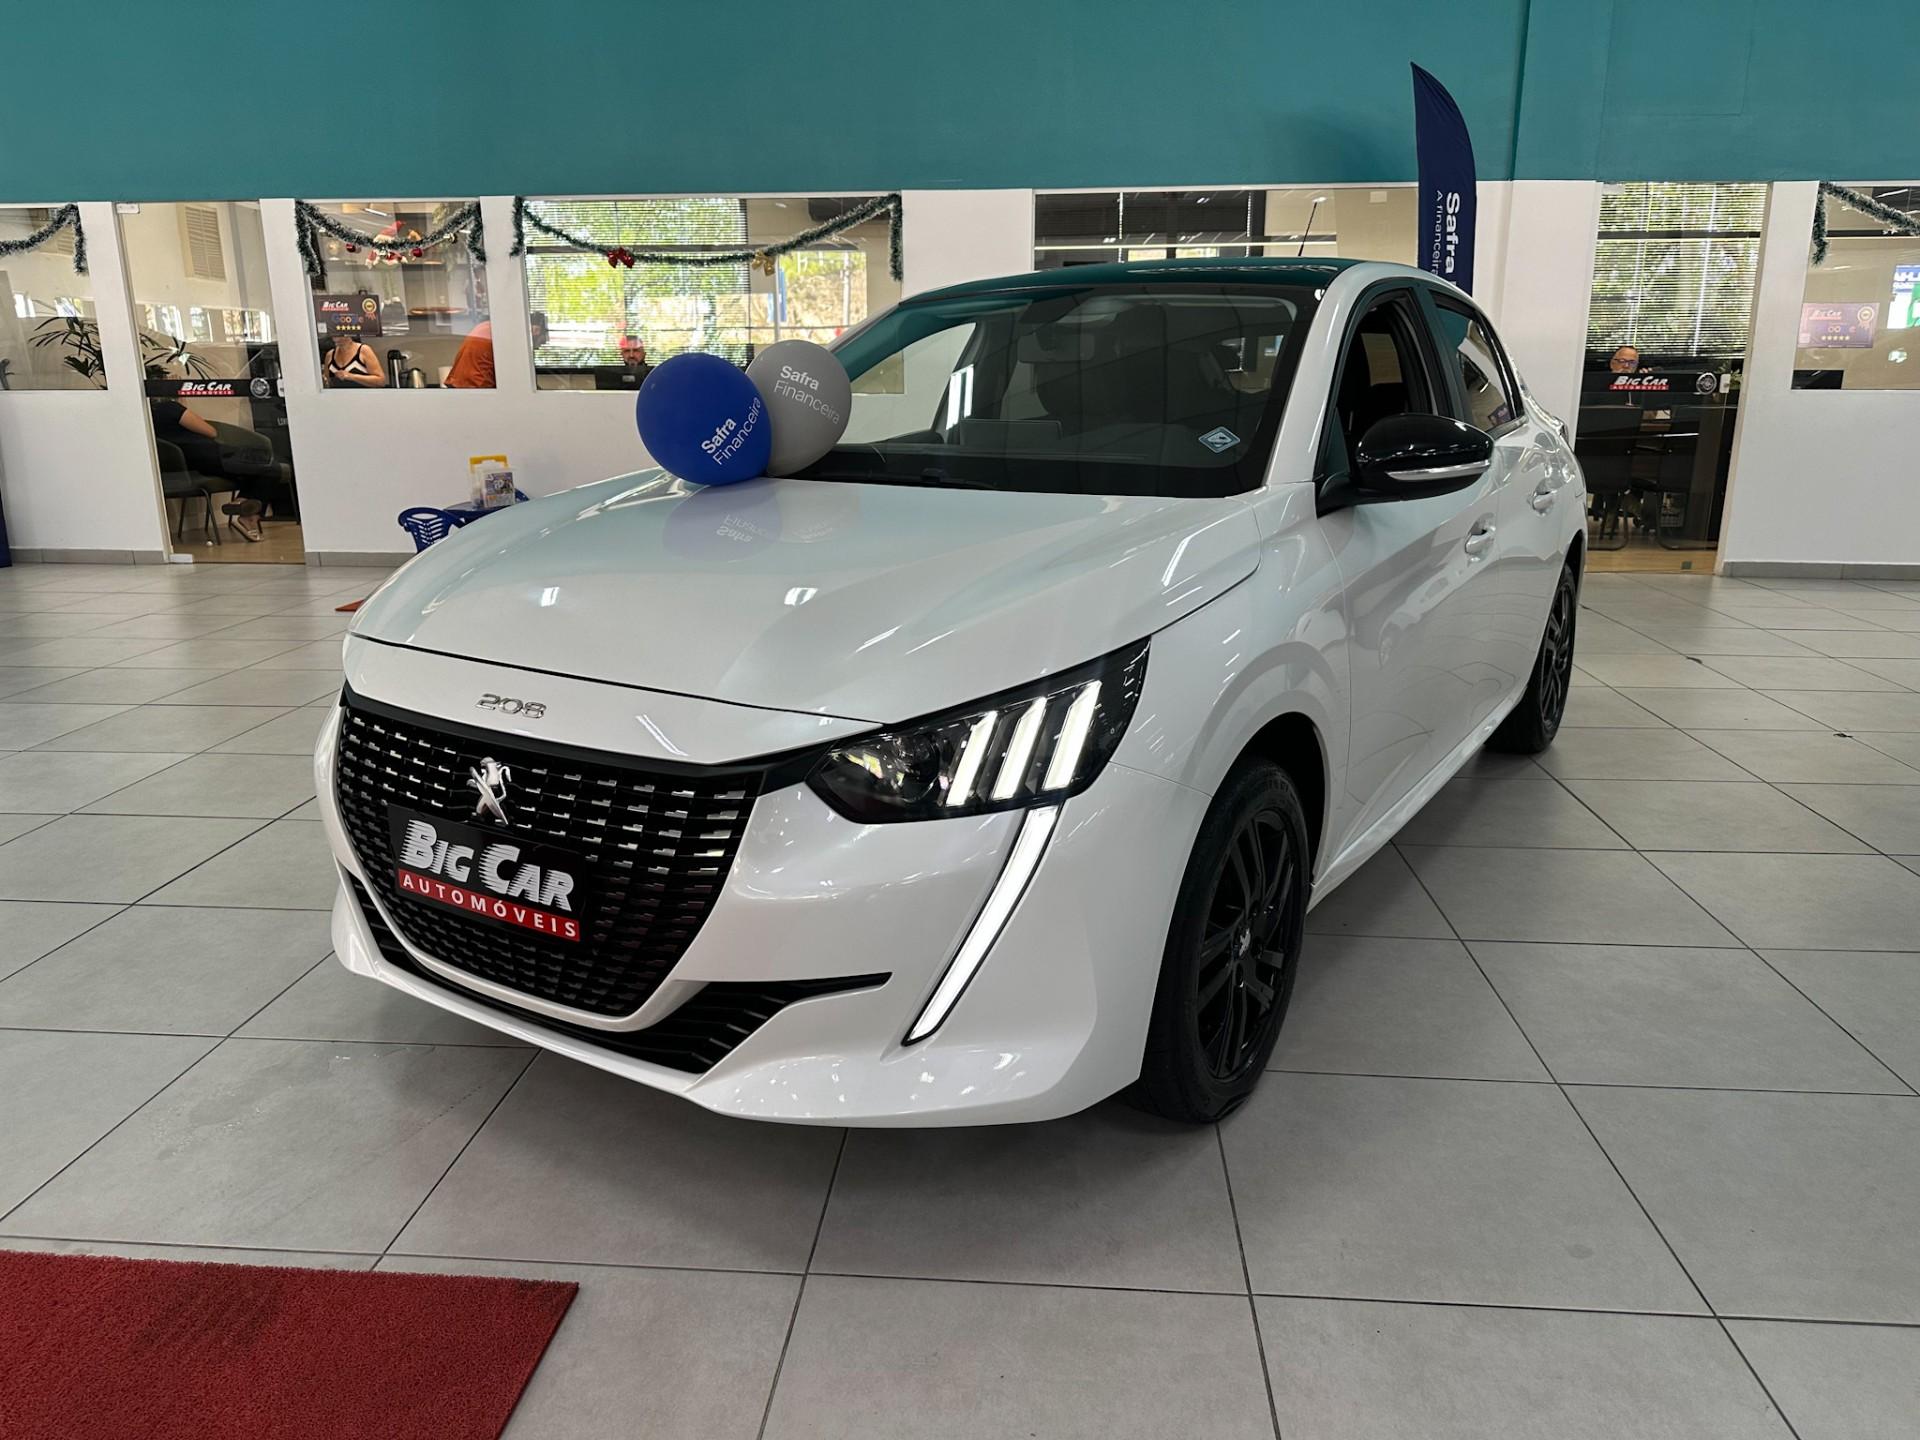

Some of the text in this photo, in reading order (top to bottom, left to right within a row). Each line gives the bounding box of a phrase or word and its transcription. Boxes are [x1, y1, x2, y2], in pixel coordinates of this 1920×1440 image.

[1436, 190, 1443, 201] A
[1445, 192, 1460, 274] Safra
[181, 381, 232, 392] BIG CAR
[780, 365, 820, 391] Safra
[1613, 375, 1669, 386] BIG CAR
[773, 379, 840, 425] Financeira
[701, 418, 737, 454] Safra
[712, 397, 761, 465] Financeira
[474, 693, 548, 720] 208
[400, 819, 575, 912] BIG CAR
[402, 873, 577, 938] AUTOMÓVEIS
